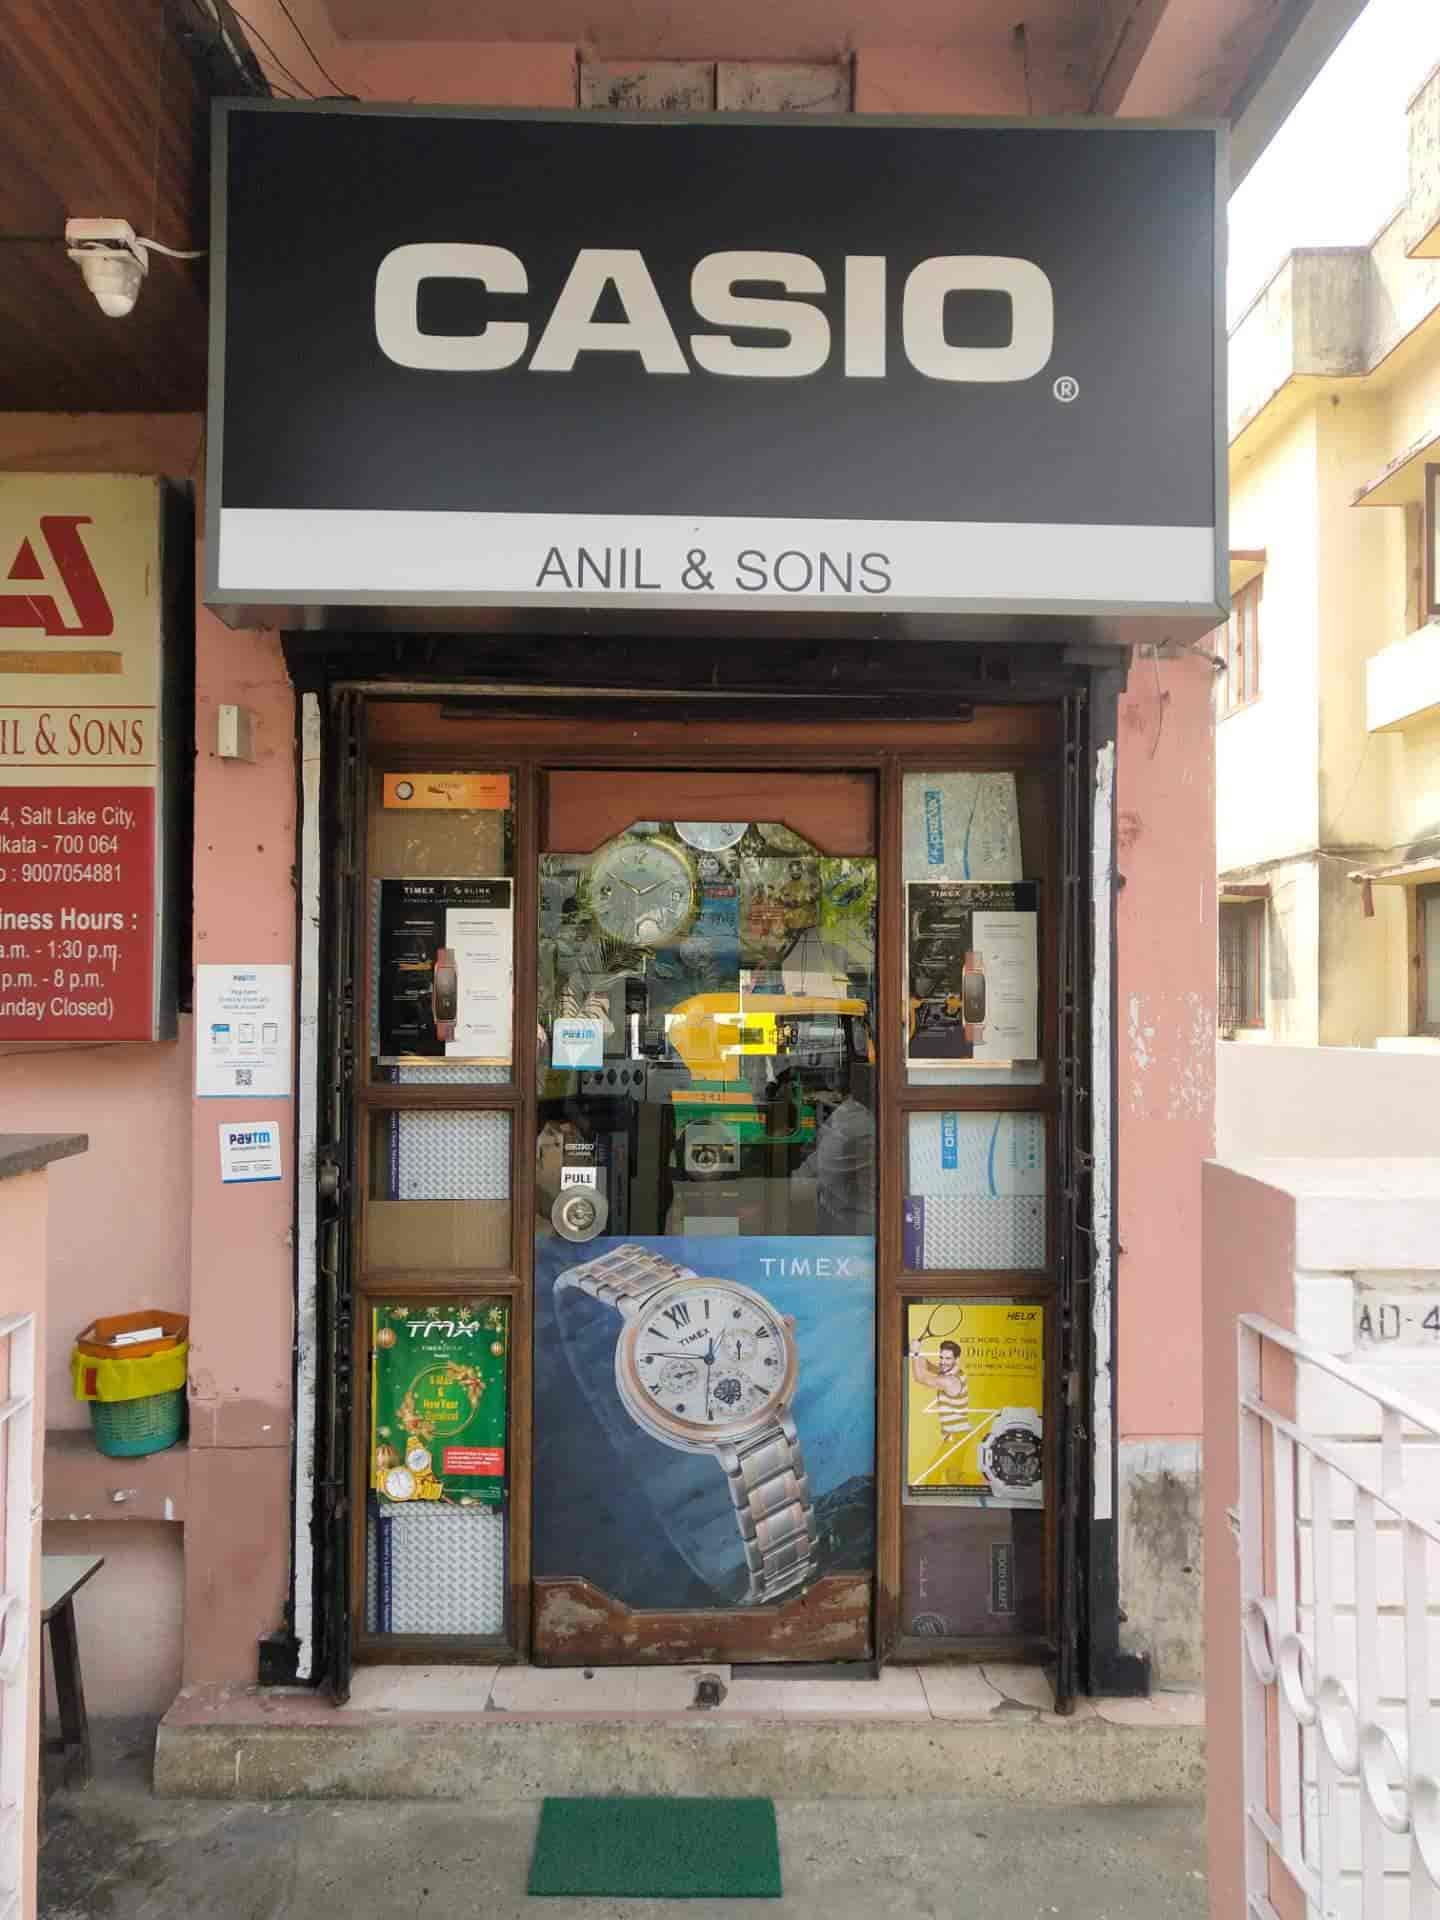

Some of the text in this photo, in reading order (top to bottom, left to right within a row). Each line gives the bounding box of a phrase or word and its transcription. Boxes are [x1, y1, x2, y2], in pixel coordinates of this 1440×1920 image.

[374, 242, 1054, 382] CASIO
[536, 547, 892, 593] ANIL & SONS
[35, 713, 58, 755] &
[20, 805, 52, 825] Salt
[57, 805, 96, 825] Lake
[101, 805, 136, 830] City,
[53, 835, 83, 853] 700
[89, 835, 118, 854] 064
[21, 864, 121, 883] 9007054881
[61, 908, 124, 930] Hours
[48, 940, 82, 959] 1:30
[88, 944, 123, 964] p.m.
[2, 972, 38, 992] p.m.
[54, 968, 65, 988] 8
[69, 972, 105, 992] p.m.
[50, 996, 114, 1021] Closed)
[564, 1173, 593, 1184] PULL
[760, 1258, 852, 1276] TIMEX
[1006, 1311, 1038, 1321] HELIX
[679, 1328, 710, 1347] TIMEX
